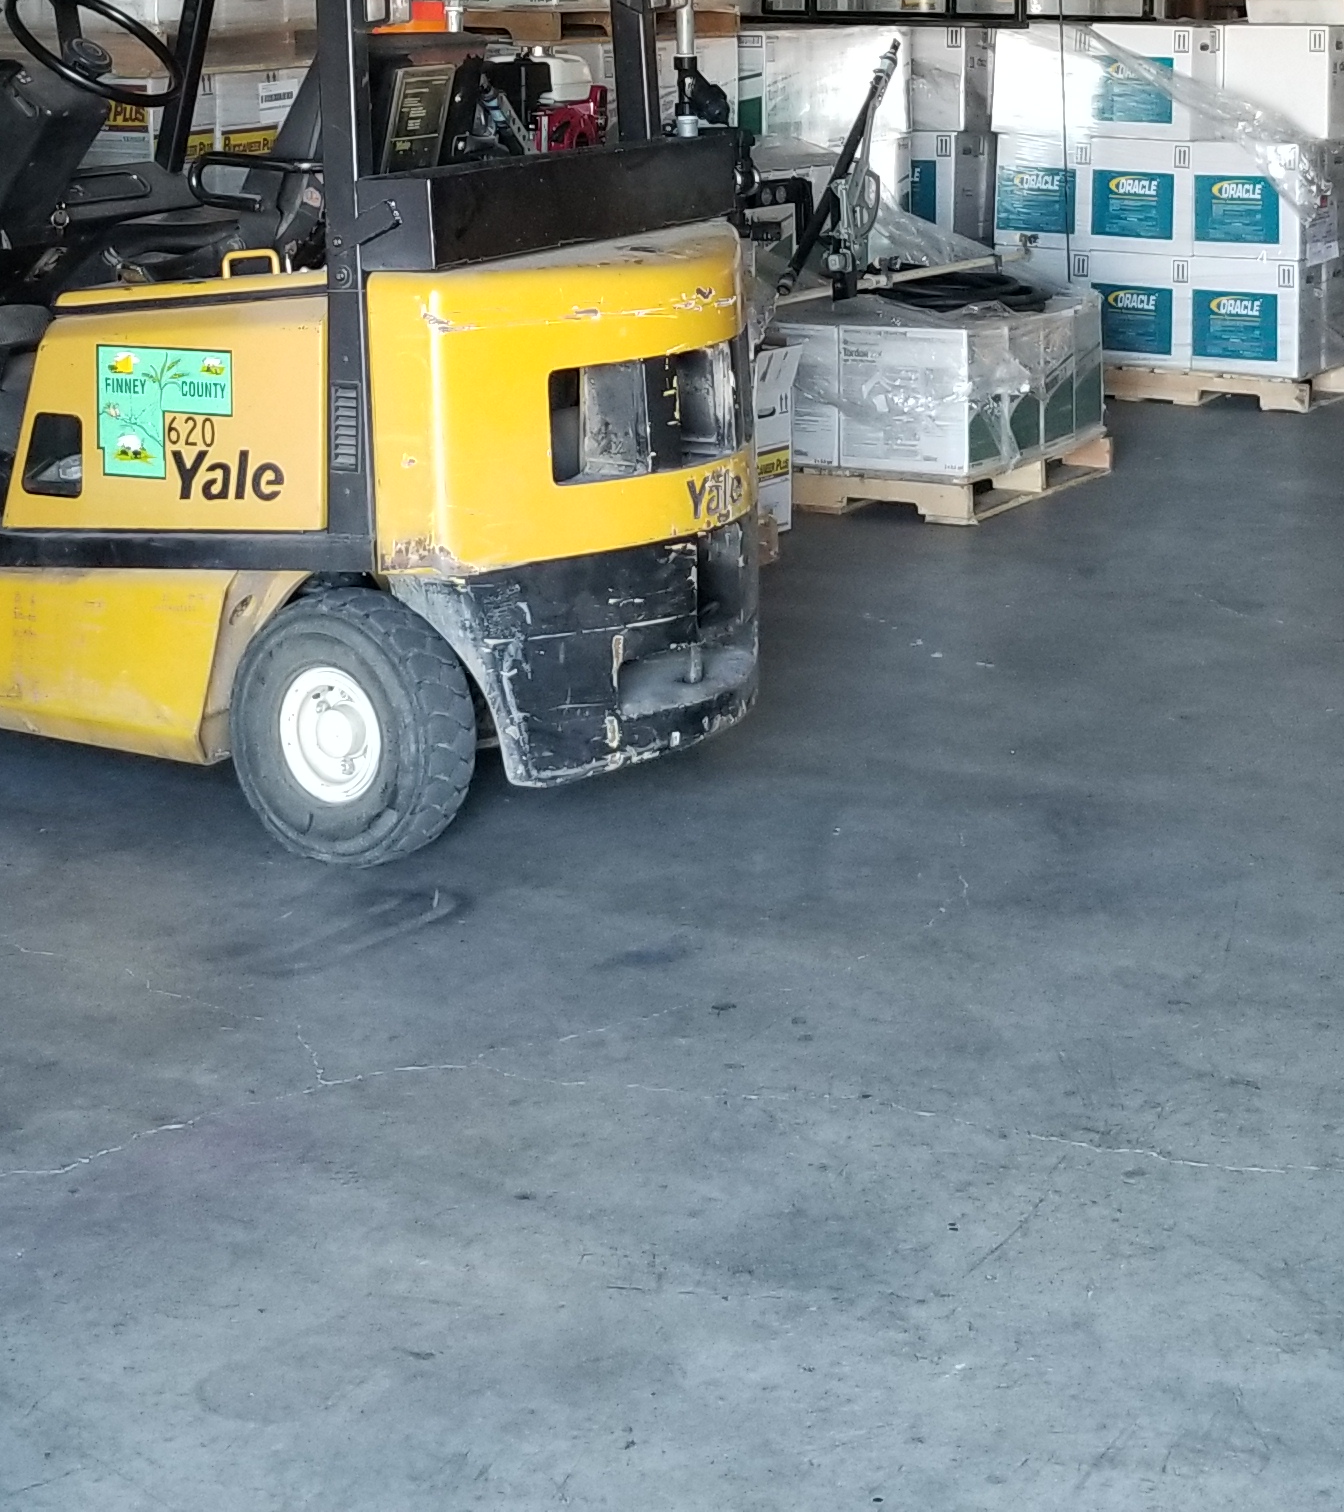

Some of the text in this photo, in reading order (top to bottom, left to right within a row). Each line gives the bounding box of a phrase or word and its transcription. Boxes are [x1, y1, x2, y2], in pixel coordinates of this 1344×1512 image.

[113, 102, 145, 123] PLUS
[1023, 174, 1060, 190] ORACLE
[1117, 177, 1158, 196] ORACLE
[1221, 182, 1262, 199] ORACLE
[1117, 293, 1156, 310] ORACLE
[1220, 299, 1260, 316] ORACLE
[105, 377, 226, 399] FINNEY COUNTY
[167, 415, 215, 448] 620
[171, 449, 285, 502] Yale
[687, 469, 742, 519] Yale
